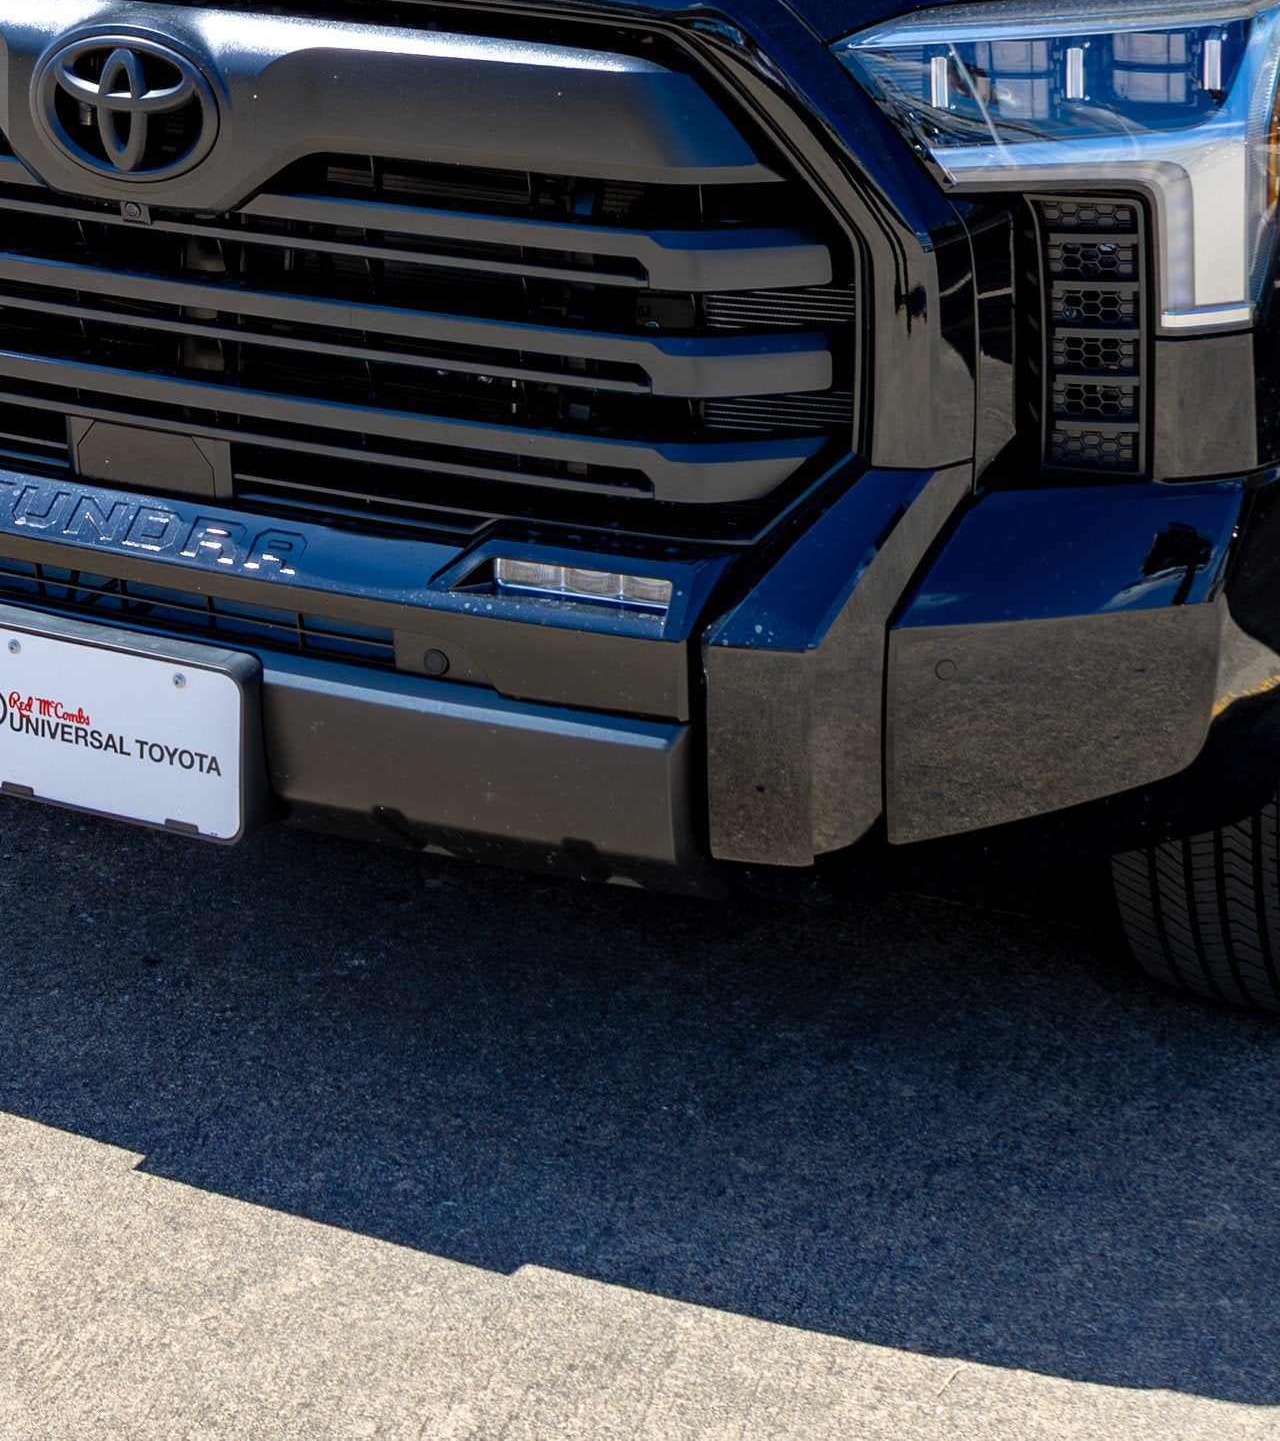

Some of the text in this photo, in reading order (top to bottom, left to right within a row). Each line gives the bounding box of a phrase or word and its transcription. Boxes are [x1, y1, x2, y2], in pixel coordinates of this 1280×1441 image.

[8, 691, 91, 726] Red McCombs
[9, 712, 222, 777] UNIVERSAL TOYOTA
